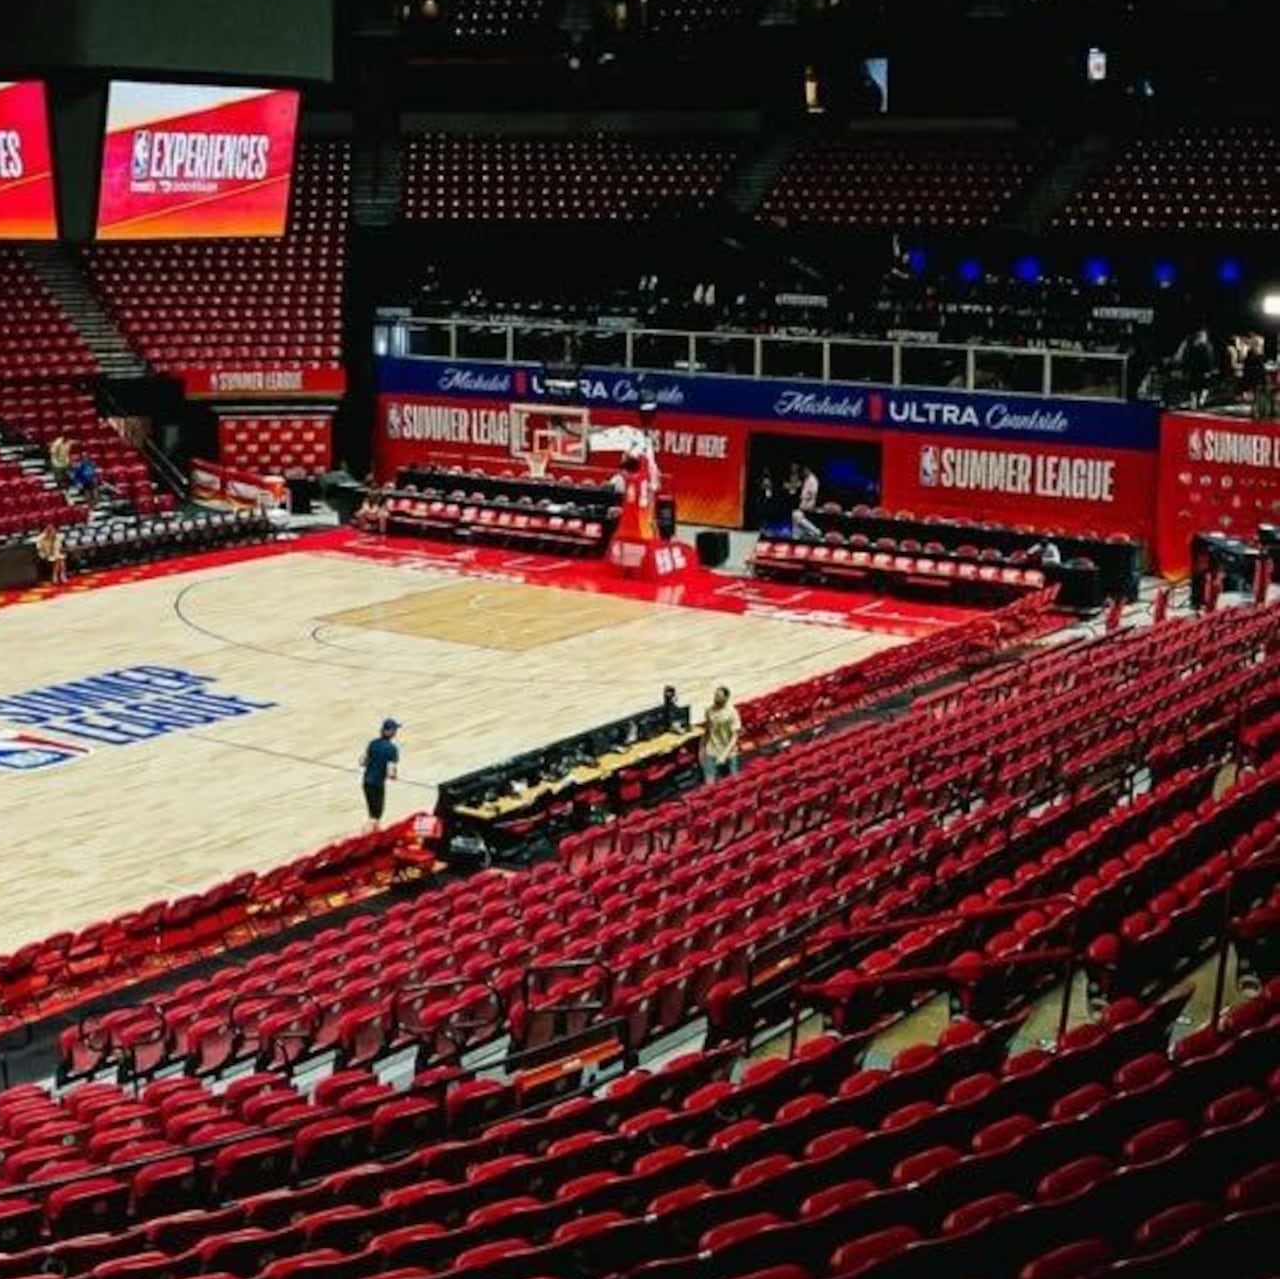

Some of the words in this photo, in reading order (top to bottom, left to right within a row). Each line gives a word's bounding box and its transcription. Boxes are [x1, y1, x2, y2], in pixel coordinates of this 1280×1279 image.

[150, 132, 269, 180] EXPERIENCES
[438, 368, 512, 392] Michelob
[403, 404, 469, 442] SUMMER
[773, 390, 863, 418] Michelob
[889, 400, 979, 427] ULTRA
[985, 403, 1069, 433] Courtside
[664, 430, 694, 455] PLAY
[695, 433, 728, 459] HERE
[1204, 429, 1270, 468] SUMMER
[941, 447, 1032, 494] SUMMER
[1035, 455, 1116, 502] LEAGUE
[40, 685, 280, 746] LEAGUE
